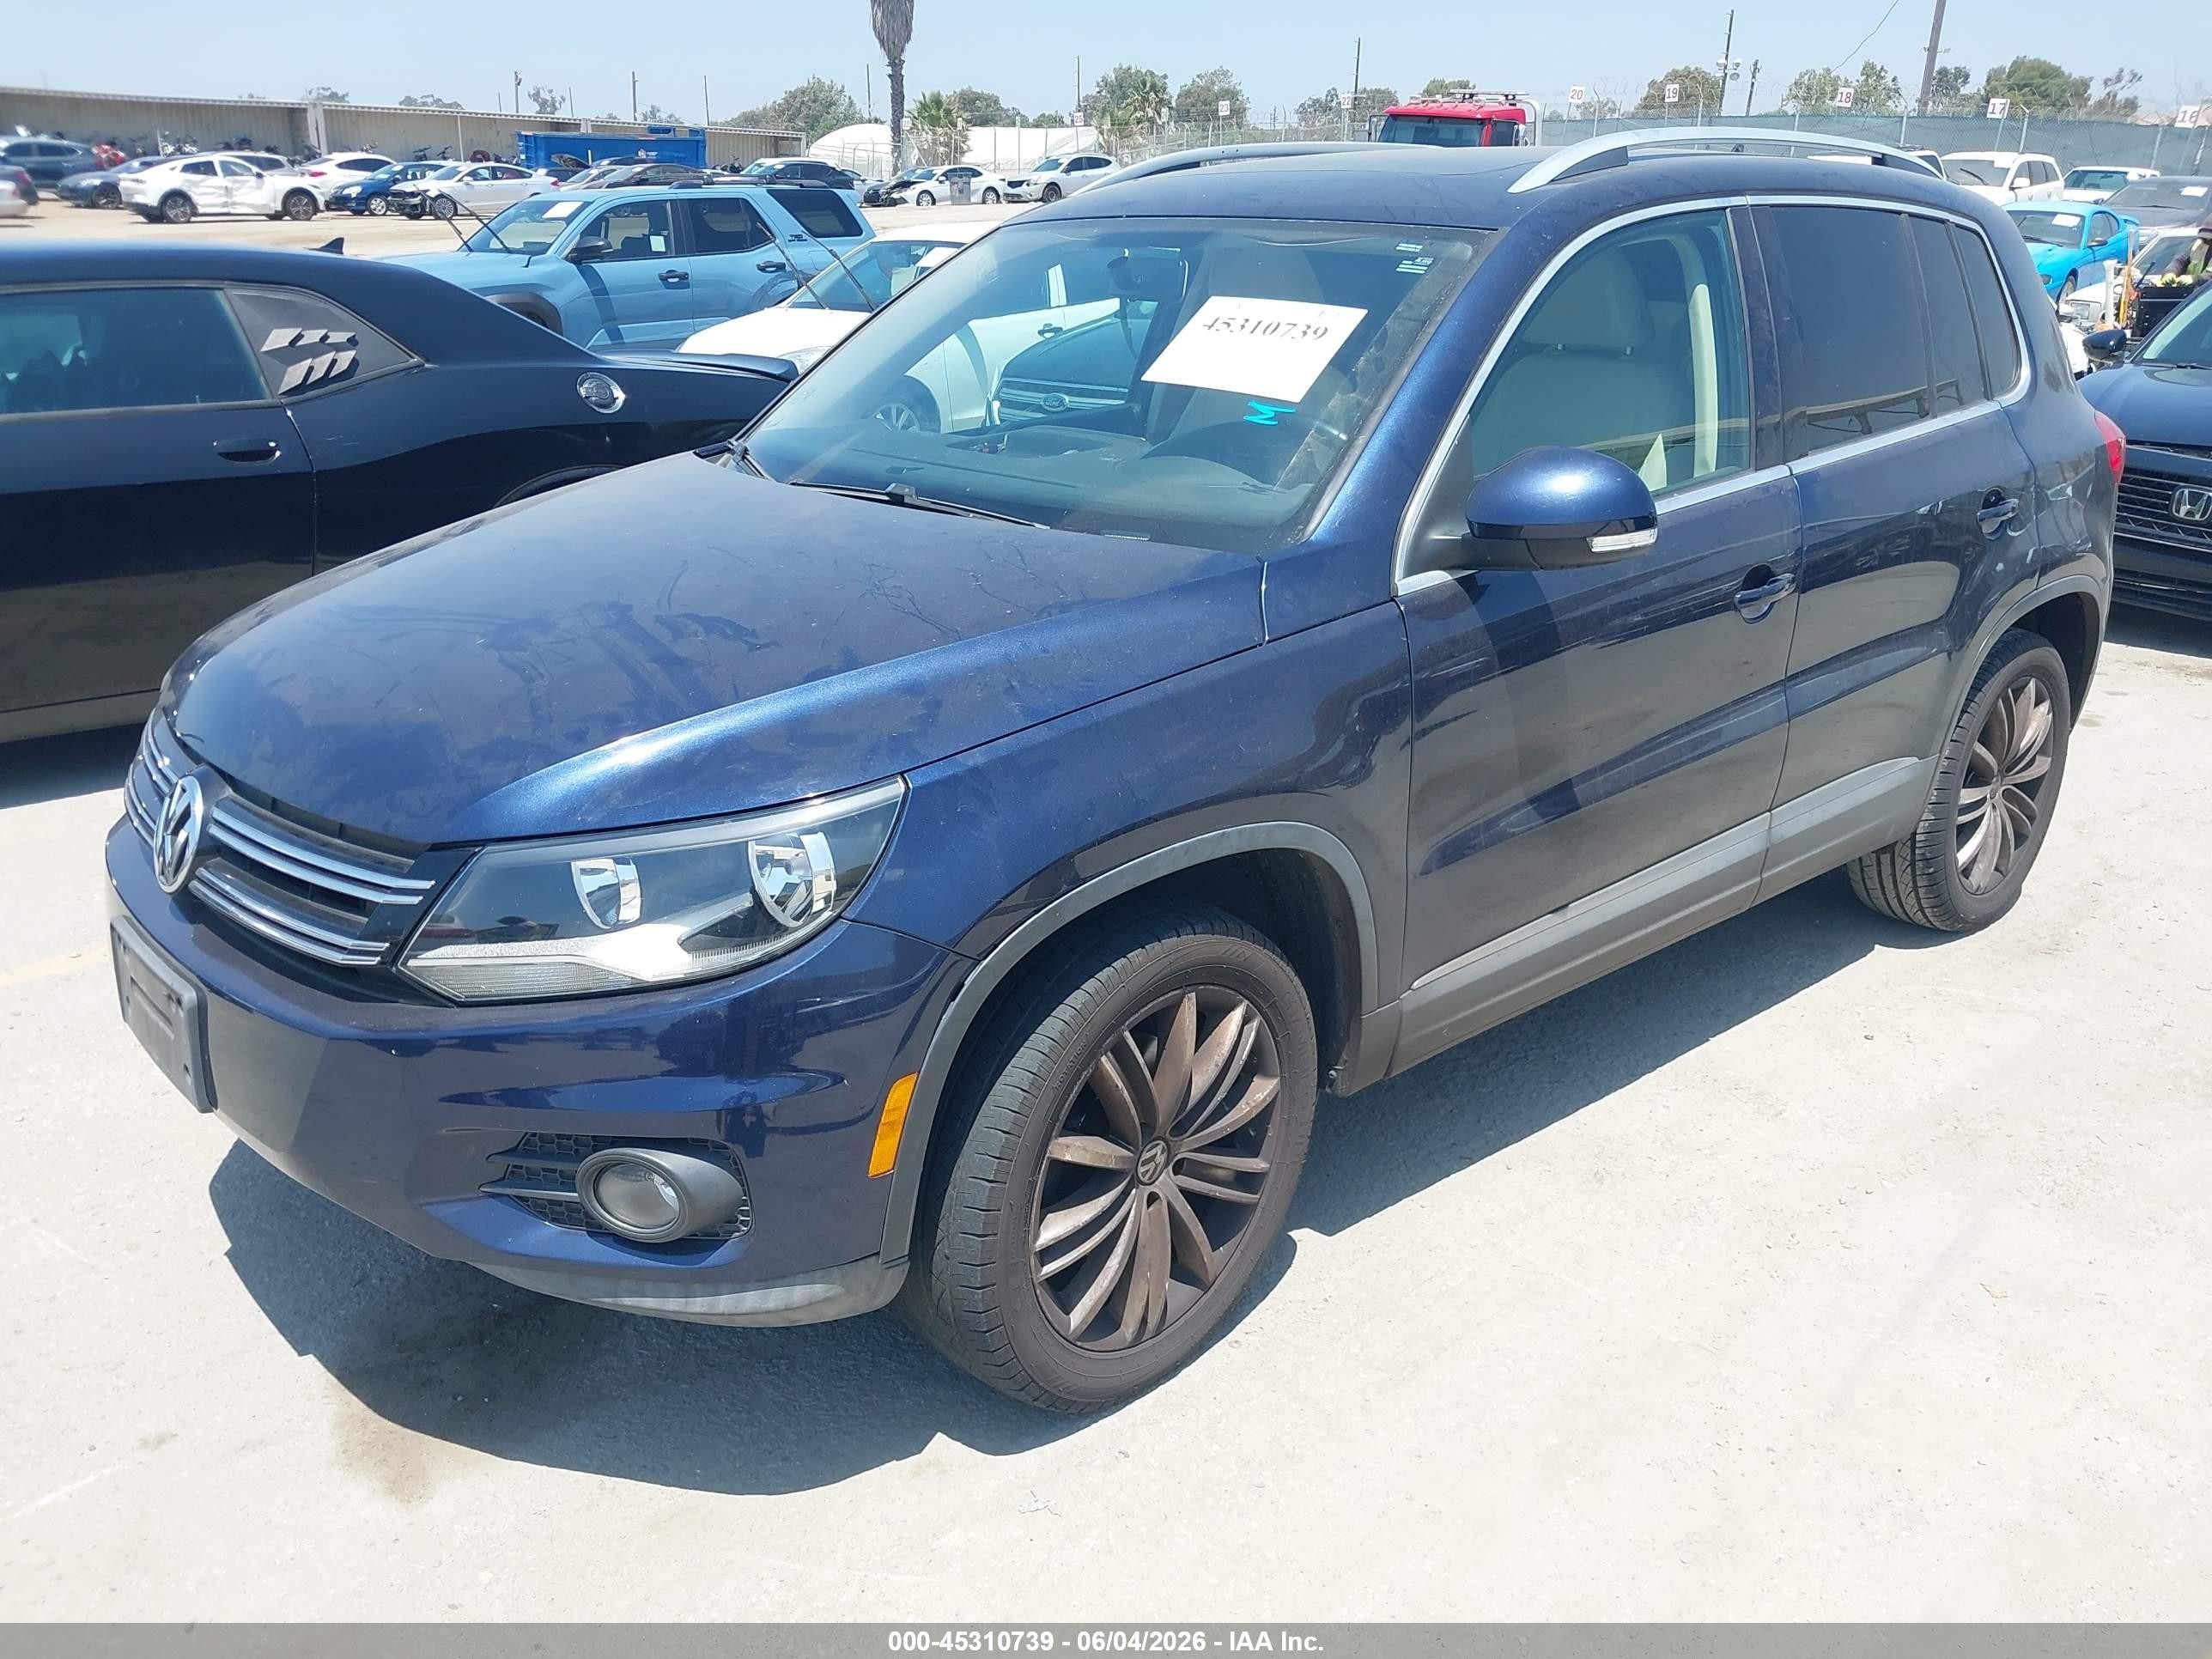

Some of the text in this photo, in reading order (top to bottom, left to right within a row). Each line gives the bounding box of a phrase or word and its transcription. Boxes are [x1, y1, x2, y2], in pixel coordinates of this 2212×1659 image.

[1570, 88, 1583, 100] 20
[1666, 88, 1678, 99] 19
[1837, 91, 1852, 104] 18
[1341, 96, 1352, 106] 22
[1219, 104, 1229, 112] 23
[1988, 102, 2006, 115] 17
[1074, 115, 1084, 124] 25
[1202, 316, 1329, 341] 45310739
